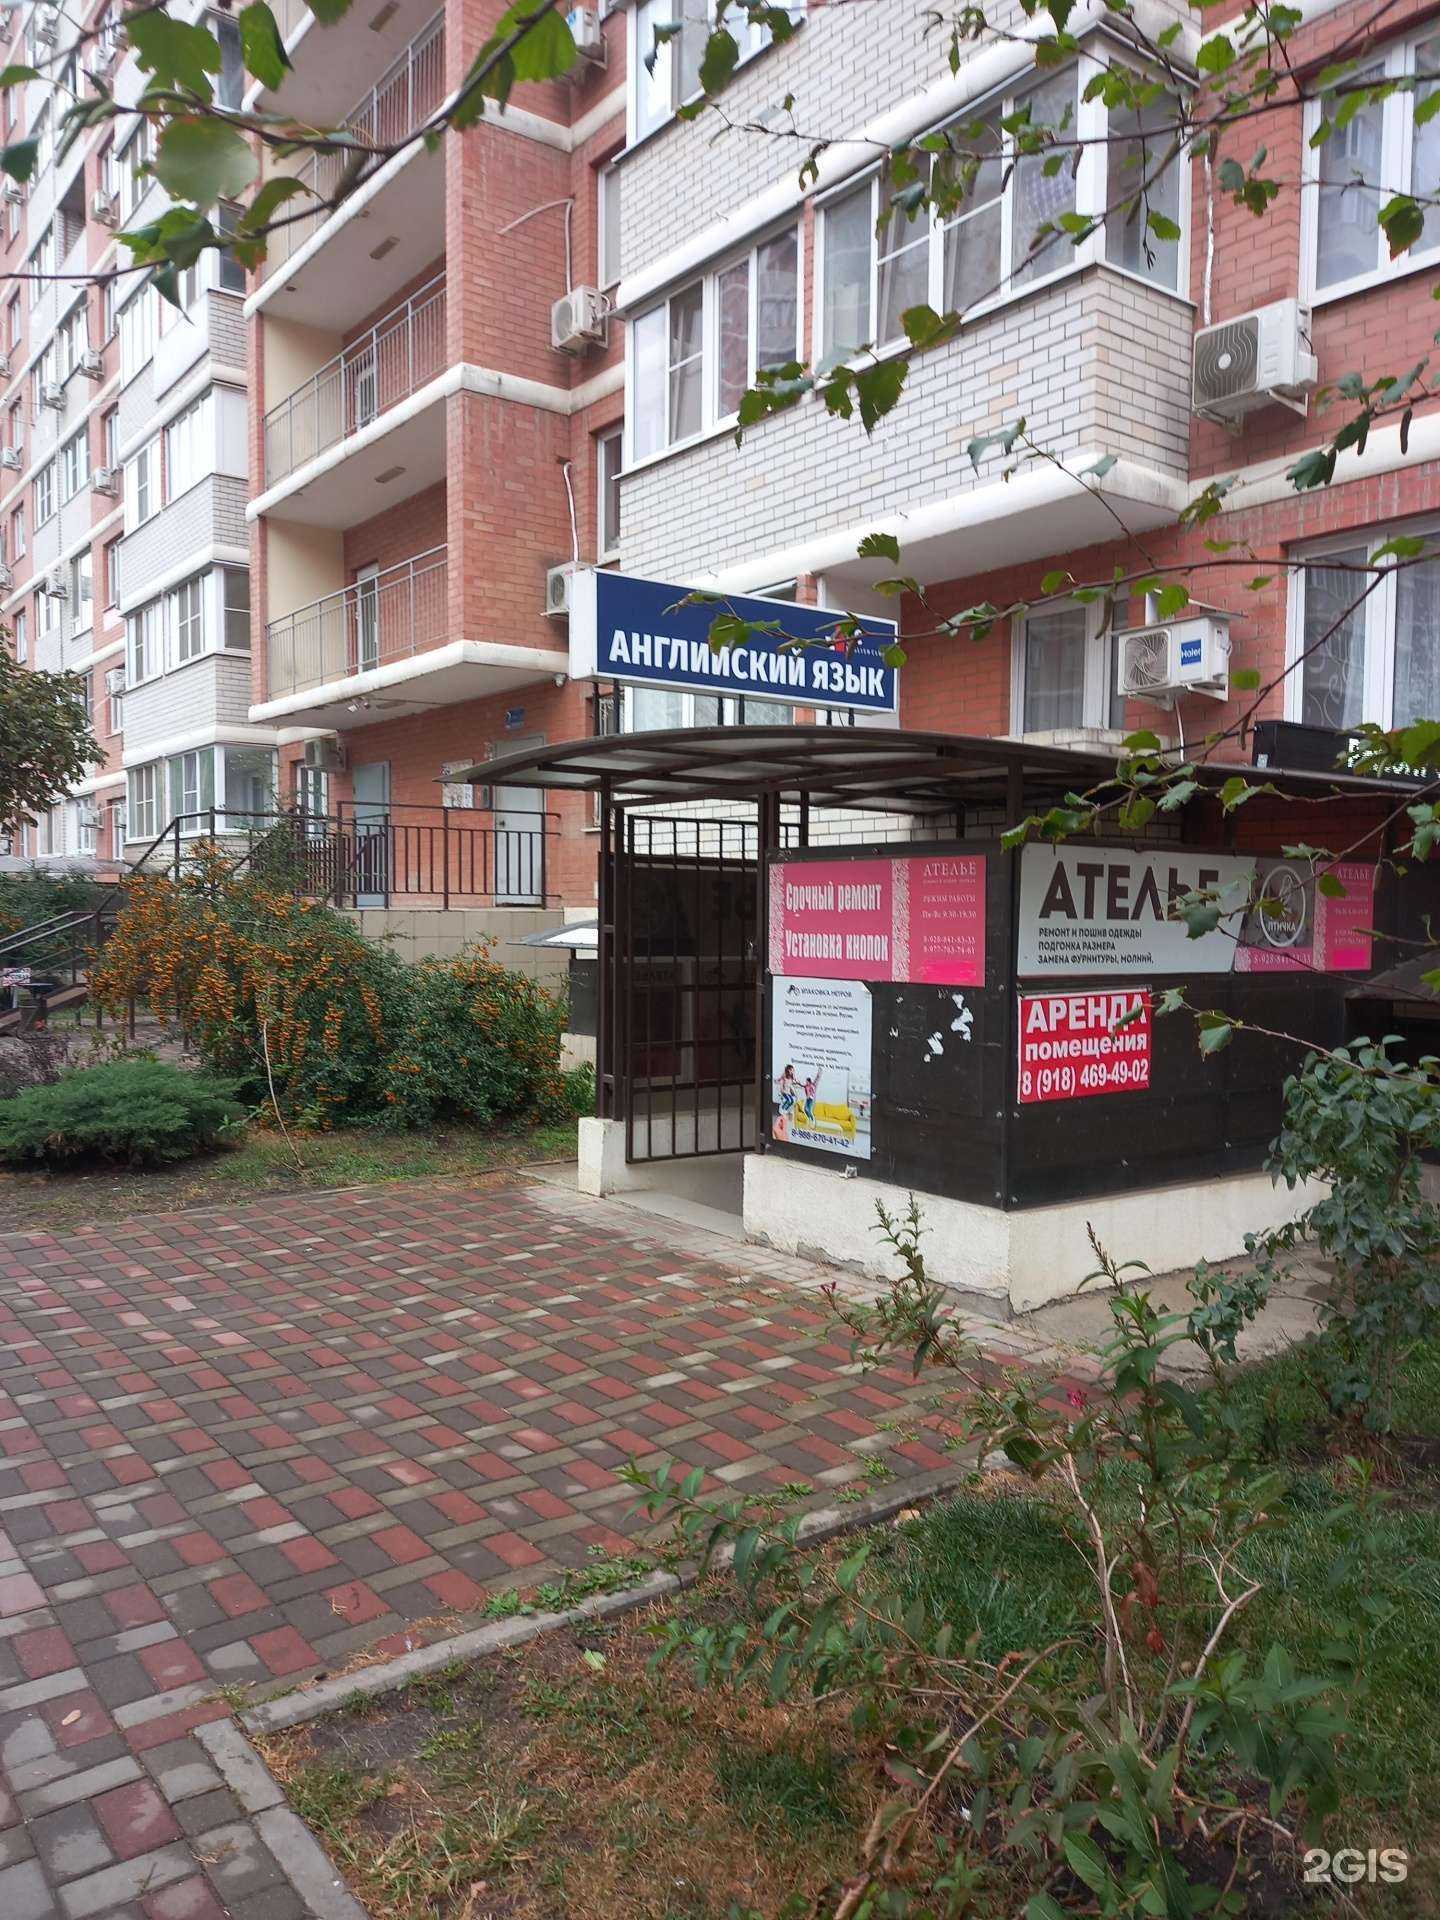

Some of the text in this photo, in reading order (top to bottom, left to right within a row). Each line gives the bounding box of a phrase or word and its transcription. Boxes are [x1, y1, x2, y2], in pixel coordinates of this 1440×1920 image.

[812, 660, 885, 698] ЯЗЫК
[923, 862, 976, 876] АТЕЛЬЕ
[1336, 867, 1370, 880] АТЕЛЬЕ
[786, 881, 882, 914] Срочный ремонт
[786, 930, 889, 961] Установка кнопок
[1038, 941, 1116, 952] ПОДГОНКА РАЗМЕРА
[1039, 927, 1142, 939] РЕМОНТ И ПОШИВ ОДЕЖДЫ
[1038, 954, 1069, 964] ЗАМЕНА
[1071, 954, 1119, 965] ФУРНИТУРЫ,
[1026, 994, 1147, 1033] АРЕНДА
[1025, 1033, 1148, 1061] помещения
[1022, 1058, 1149, 1099] 8 (918) 469-49-02
